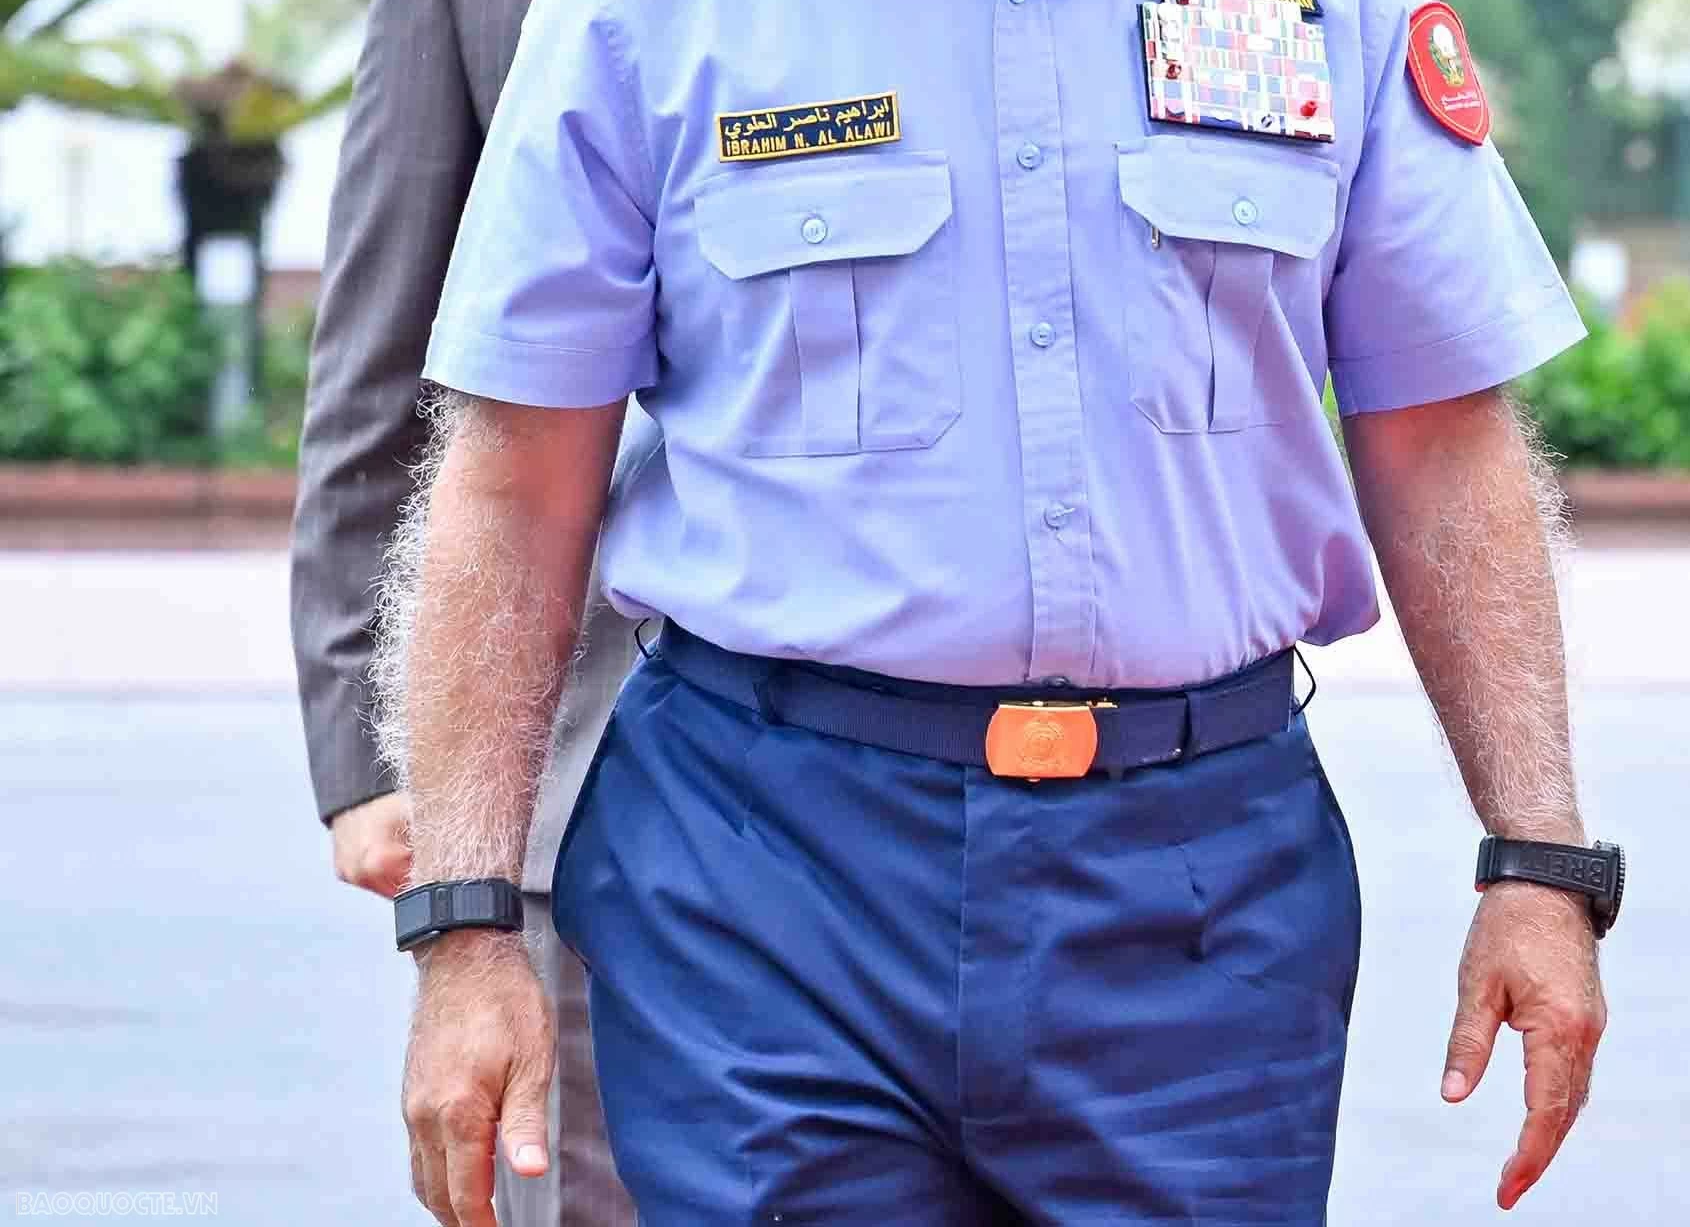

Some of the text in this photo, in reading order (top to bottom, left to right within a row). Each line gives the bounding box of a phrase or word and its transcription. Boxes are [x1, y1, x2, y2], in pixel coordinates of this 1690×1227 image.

[783, 107, 831, 131] ناصر
[726, 121, 891, 156] IBRAHIM N. AL ALAWI
